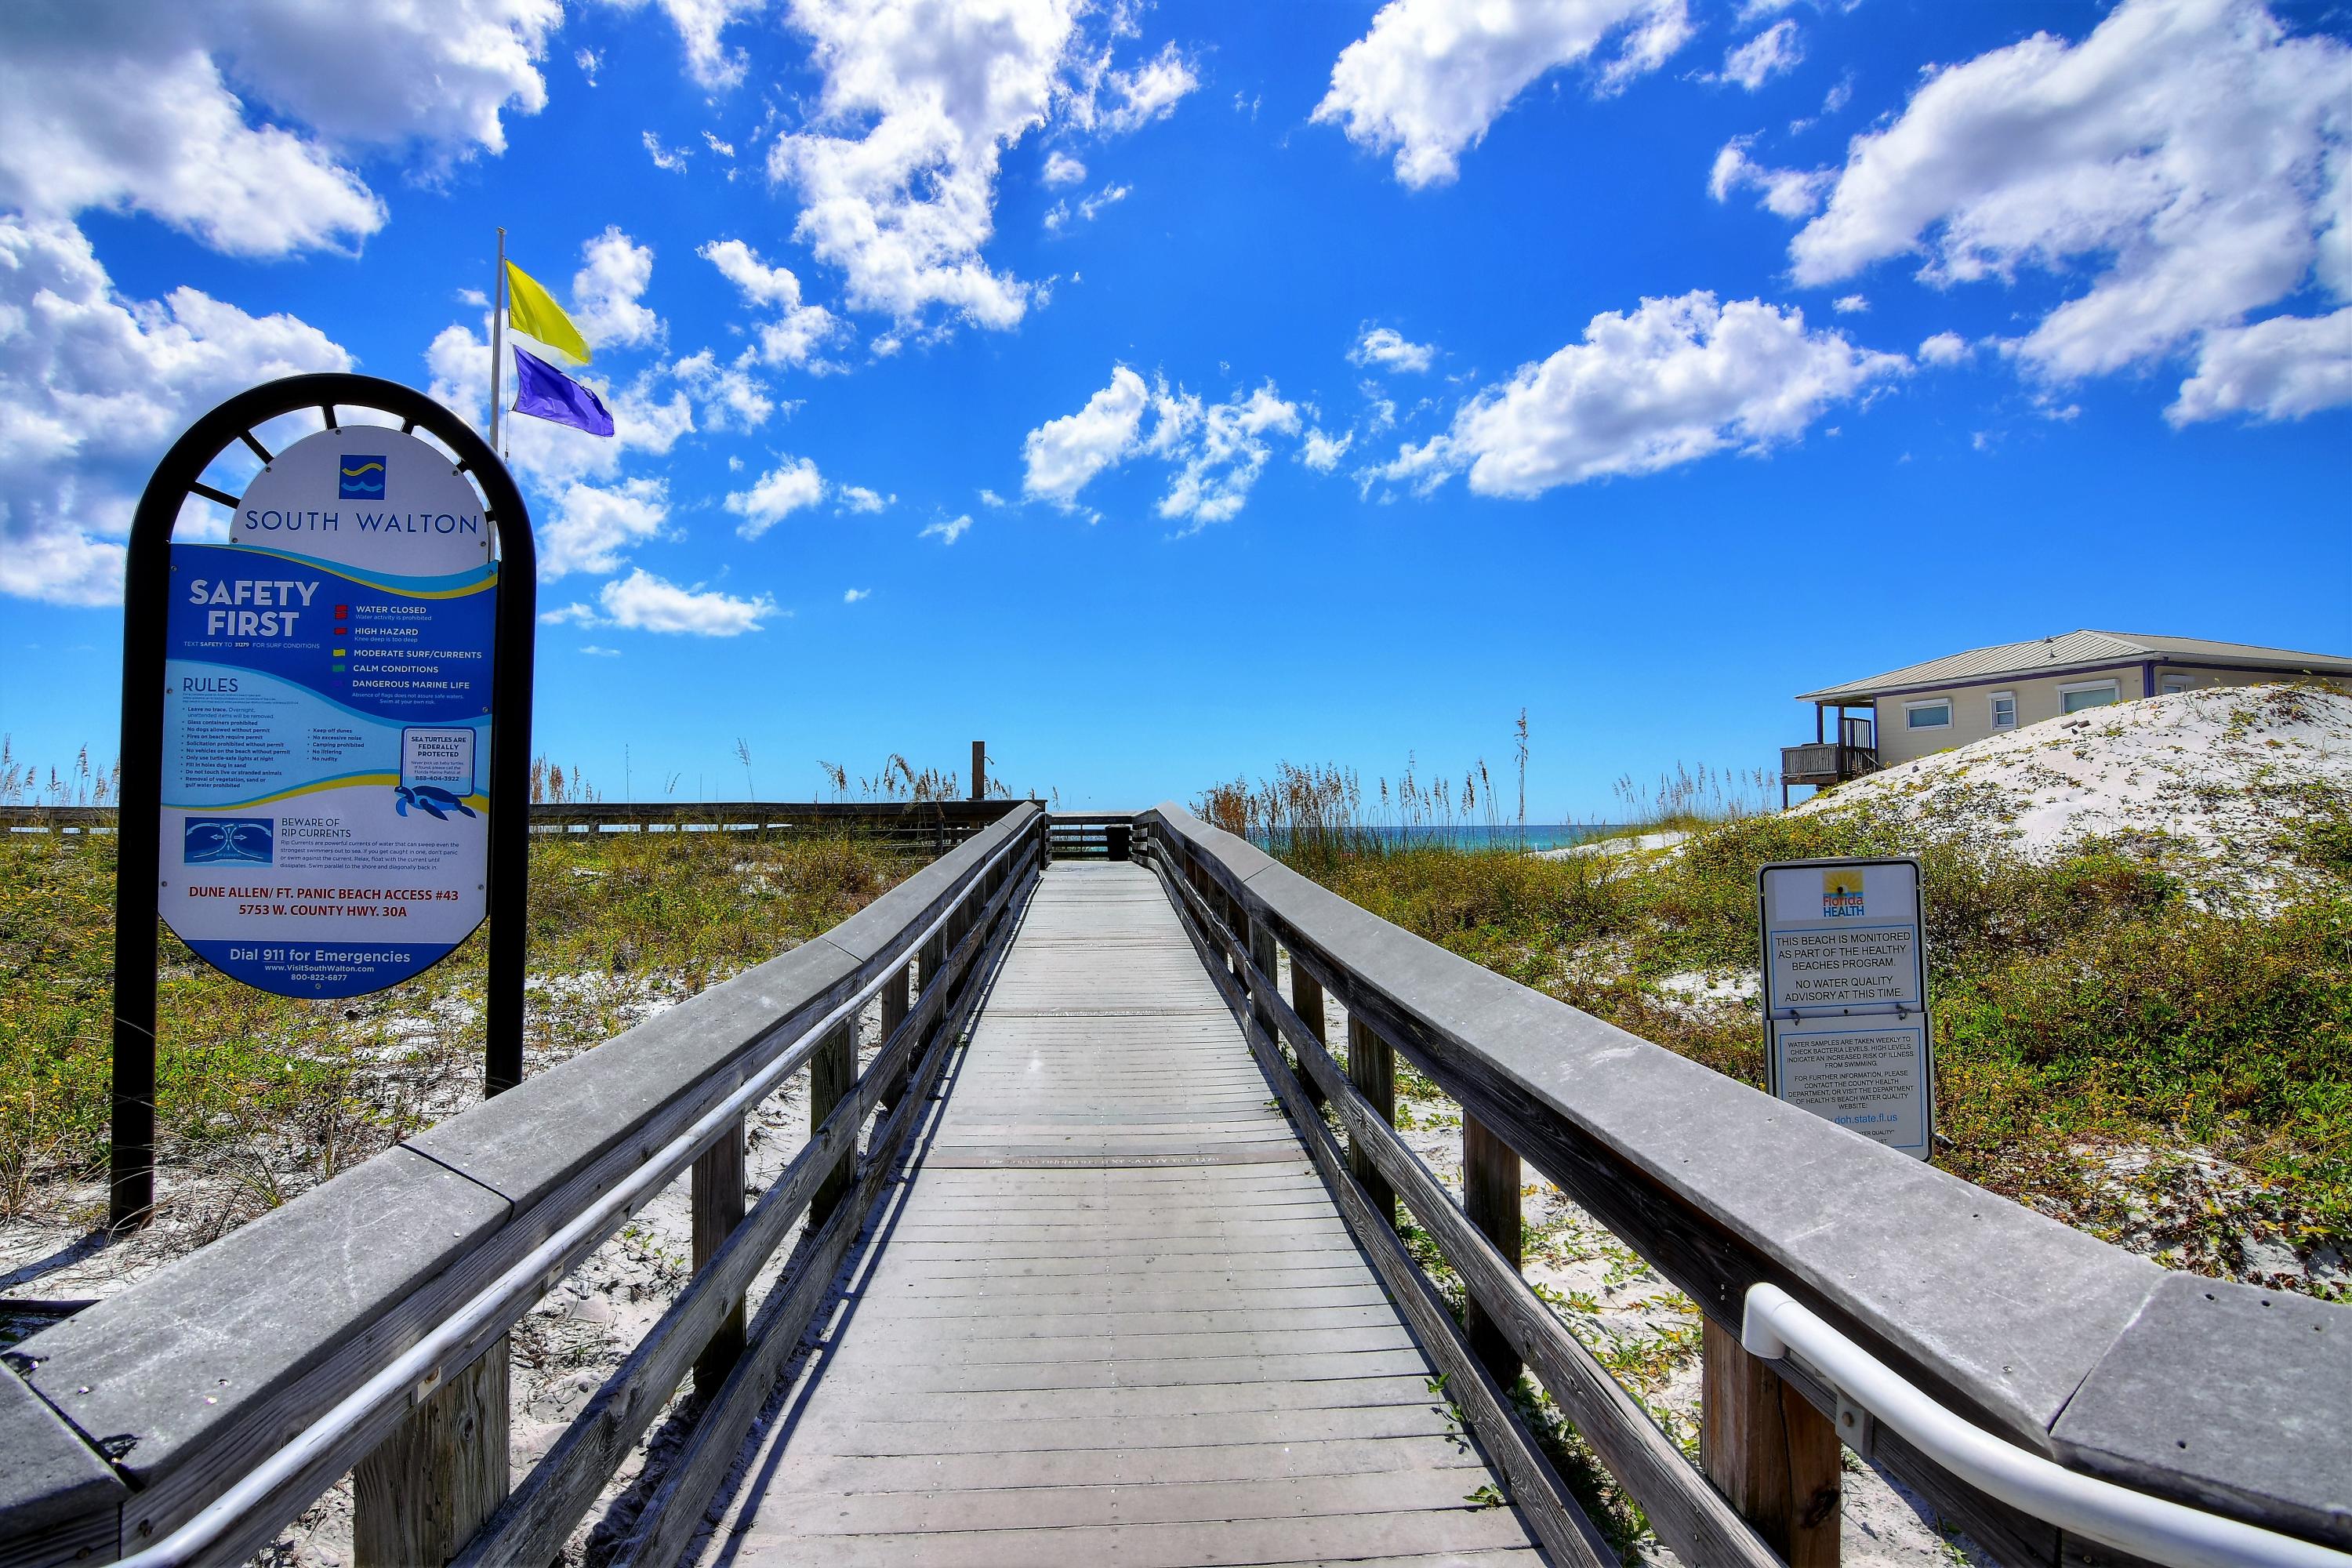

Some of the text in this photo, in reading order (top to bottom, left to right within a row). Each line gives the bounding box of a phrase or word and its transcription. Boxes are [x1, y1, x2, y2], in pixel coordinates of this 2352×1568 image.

[245, 510, 477, 533] SOUTH WALTON
[189, 579, 319, 606] SAFETY
[208, 611, 299, 637] FIRST
[183, 677, 238, 692] RULES
[282, 818, 323, 826] BEWARE
[299, 829, 350, 837] CURRENTS
[189, 887, 458, 901] DUNE ALLEN/ FT. PANIC BEACH ACCESS #43
[1824, 895, 1863, 906] Florida
[239, 905, 407, 917] 5753 W. COUNTY HWY. 30A
[1824, 906, 1864, 917] HEALTH
[1776, 932, 1910, 946] THIS BEACH IS MONITORED
[230, 948, 410, 965] Dial 911 for Emergencies
[1778, 945, 1907, 959] AS PART OF THE HEALTHY
[265, 964, 374, 972] www.VisitSouthWalton.com
[1792, 958, 1896, 971] BEACHES PROGRAM.
[1796, 976, 1893, 989] NO WATER QUALITY
[1785, 988, 1903, 1002] ADVISORY AT THIS TIME.
